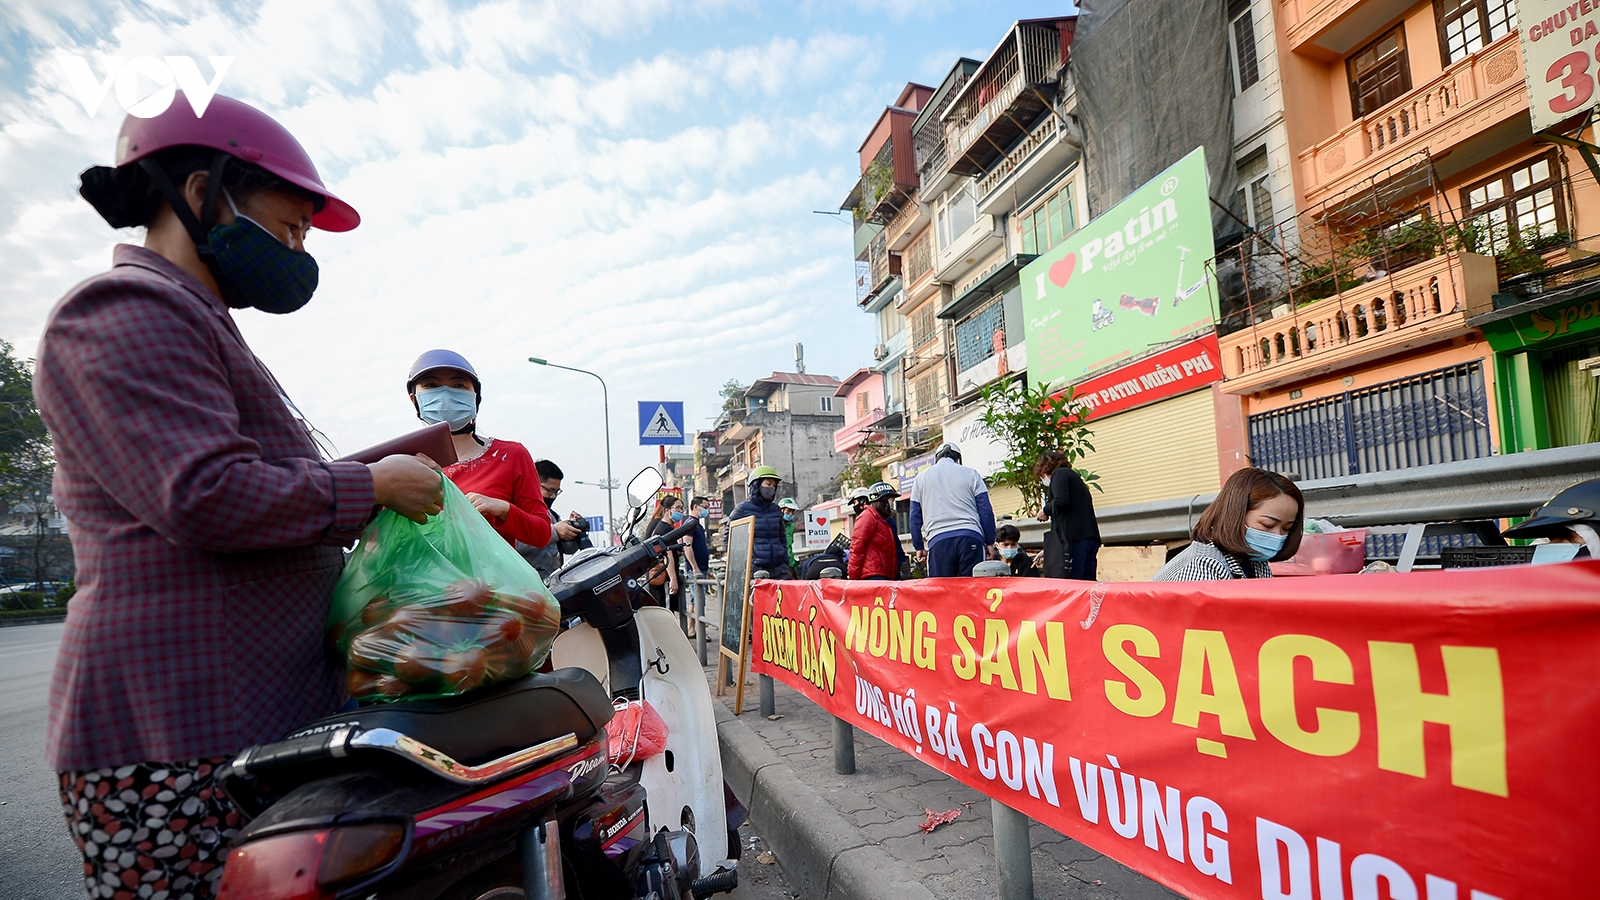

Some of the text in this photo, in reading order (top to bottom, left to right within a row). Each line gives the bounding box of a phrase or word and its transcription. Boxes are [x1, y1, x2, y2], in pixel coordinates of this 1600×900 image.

[1570, 20, 1599, 46] DA
[1546, 40, 1600, 114] 3
[1035, 271, 1046, 301] I
[1080, 197, 1178, 274] Patin
[1099, 378, 1142, 404] PATIN
[1139, 363, 1183, 391] MIỄN
[1180, 350, 1214, 377] PHÍ
[808, 514, 813, 522] I
[762, 588, 799, 675] ĐIỂM
[800, 605, 837, 696] BÁN
[845, 597, 937, 671] NÔNG
[952, 588, 1072, 701] SẢN
[1101, 624, 1508, 798] SẠCH
[888, 688, 922, 754] HỘ
[925, 700, 969, 768] BÀ
[971, 722, 1060, 808] CON
[1069, 753, 1232, 885] VÙNG
[606, 817, 628, 838] HONDA
